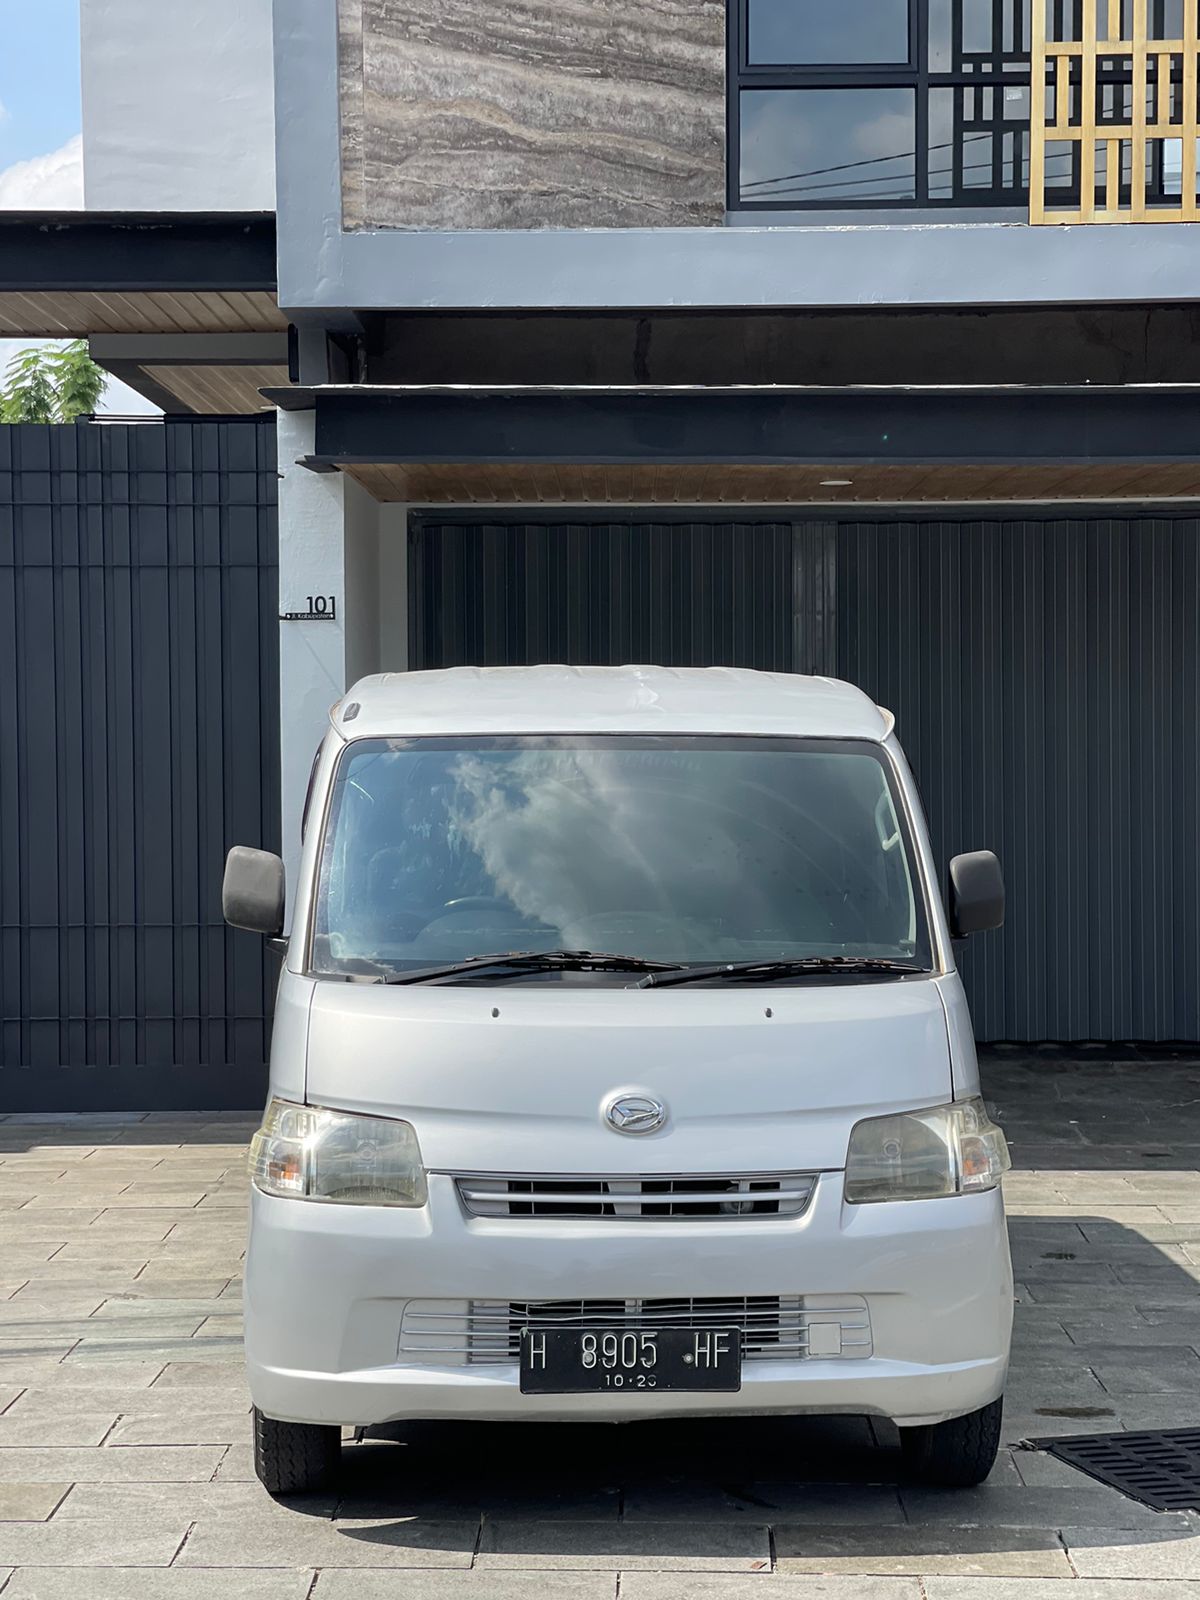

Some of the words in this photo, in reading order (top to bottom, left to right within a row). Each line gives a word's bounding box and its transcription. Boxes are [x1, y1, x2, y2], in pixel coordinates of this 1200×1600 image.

[306, 595, 335, 614] 101
[529, 1332, 546, 1369] H
[581, 1331, 657, 1369] 8905
[694, 1331, 730, 1369] HF
